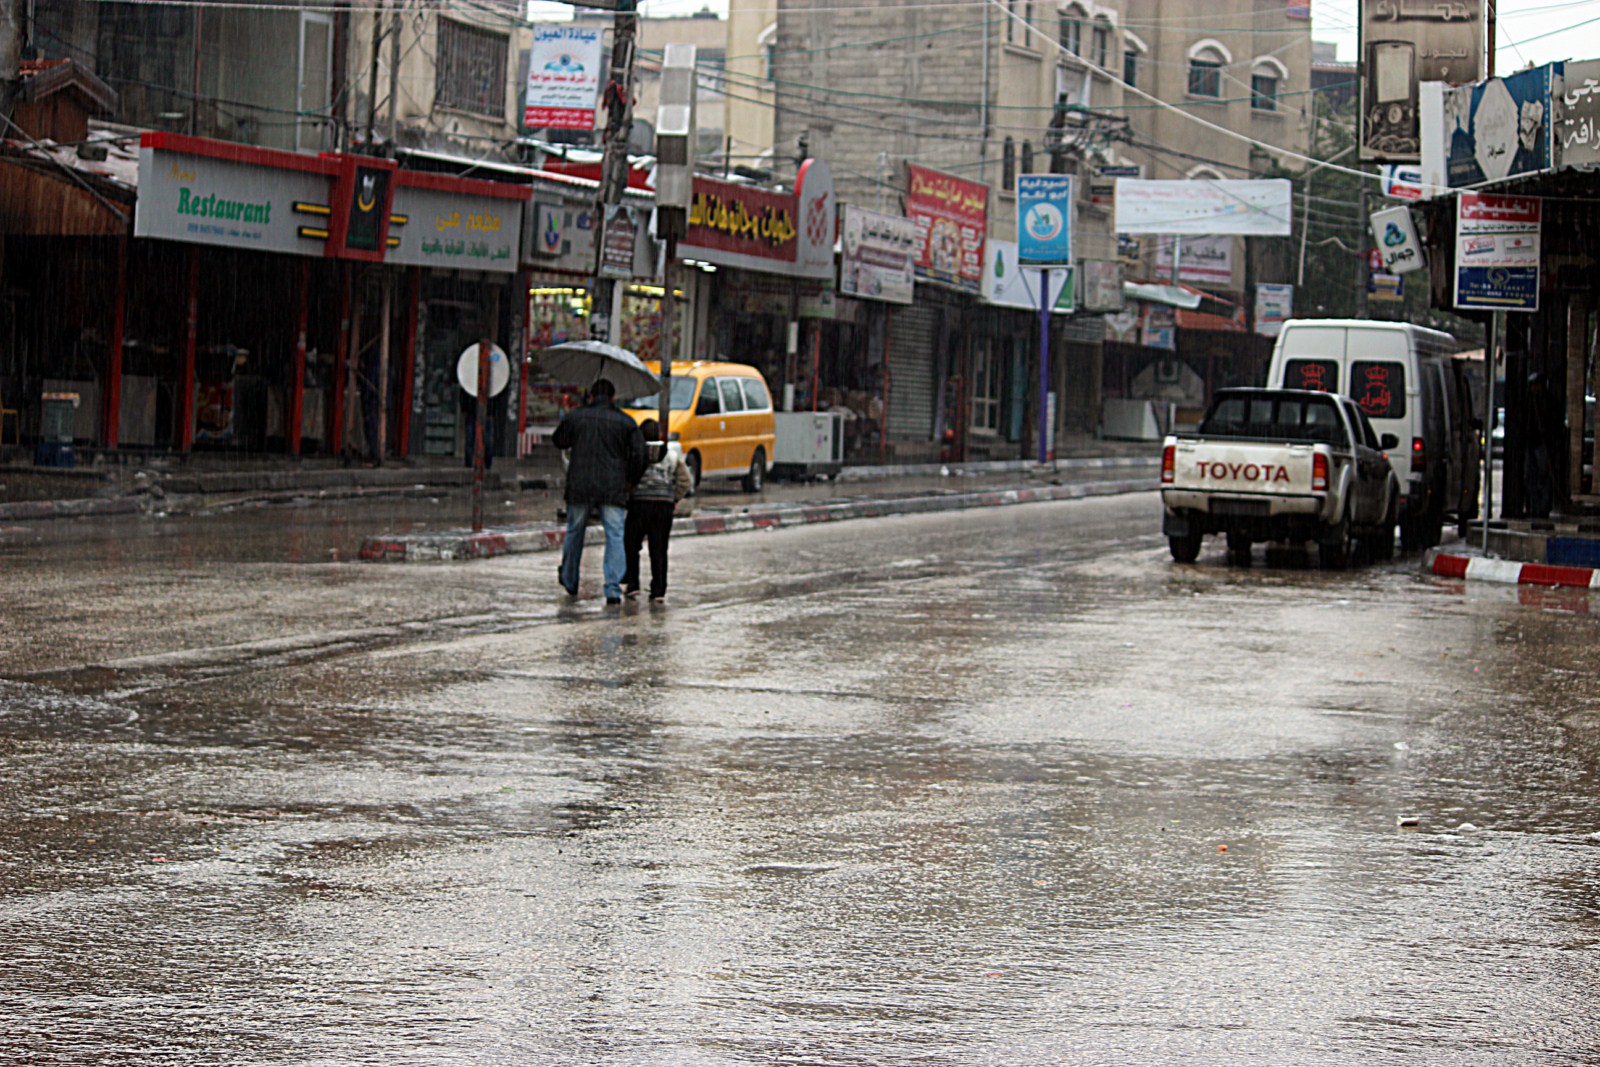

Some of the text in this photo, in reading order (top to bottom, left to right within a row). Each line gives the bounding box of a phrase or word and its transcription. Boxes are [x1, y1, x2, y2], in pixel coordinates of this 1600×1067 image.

[534, 27, 597, 44] عيادة العيون
[1020, 178, 1068, 191] صيدلية
[177, 187, 272, 225] Restaurant
[1462, 199, 1536, 218] الخليجي
[466, 208, 501, 234] مطعم
[1384, 247, 1415, 266] جوال
[1197, 461, 1291, 483] TOYOTA
